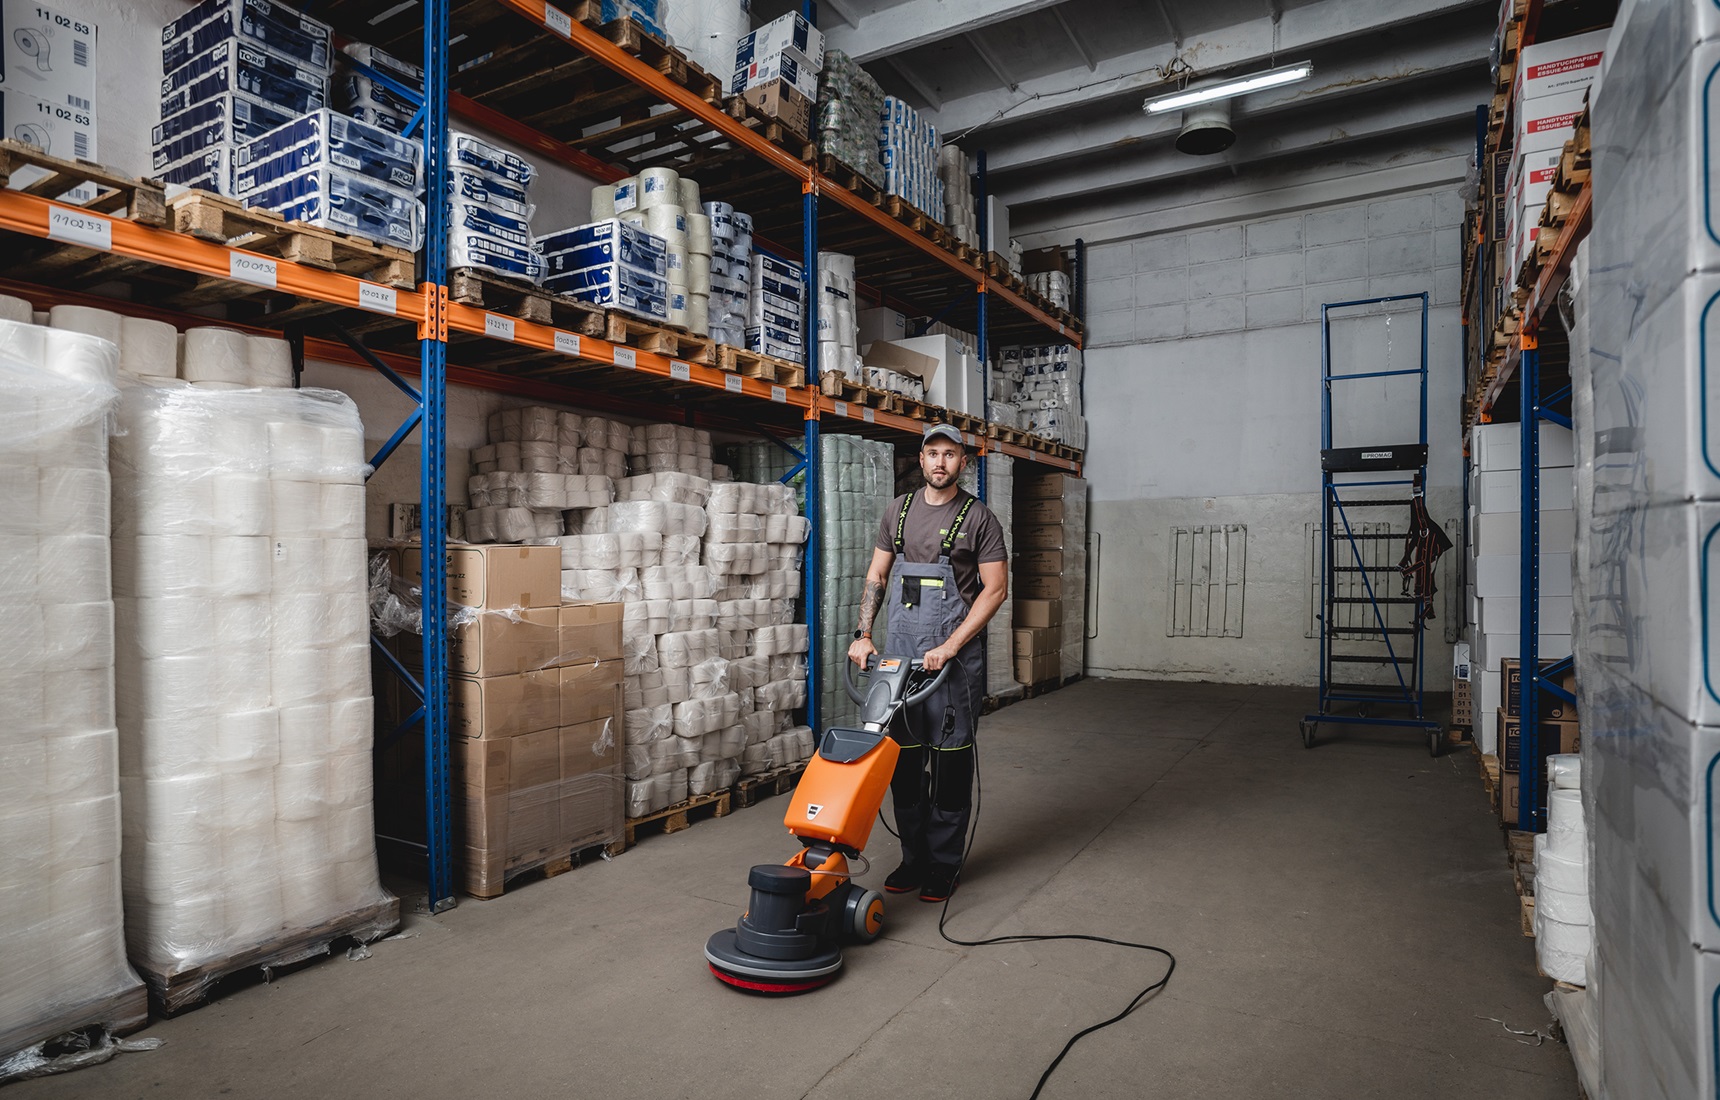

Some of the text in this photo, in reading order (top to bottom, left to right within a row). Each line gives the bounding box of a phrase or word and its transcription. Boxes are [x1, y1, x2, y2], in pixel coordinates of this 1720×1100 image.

[36, 8, 89, 35] 11 02 53
[240, 51, 264, 65] TORK
[1537, 54, 1599, 71] HANDTUCHPAPIER
[1537, 62, 1585, 77] ESSUIE-MAINS
[37, 103, 89, 126] 11 02 53
[1537, 114, 1577, 125] HANDTUCH
[1537, 120, 1573, 131] ESSUIE-MA
[393, 169, 413, 183] TORK
[391, 225, 410, 238] TORK
